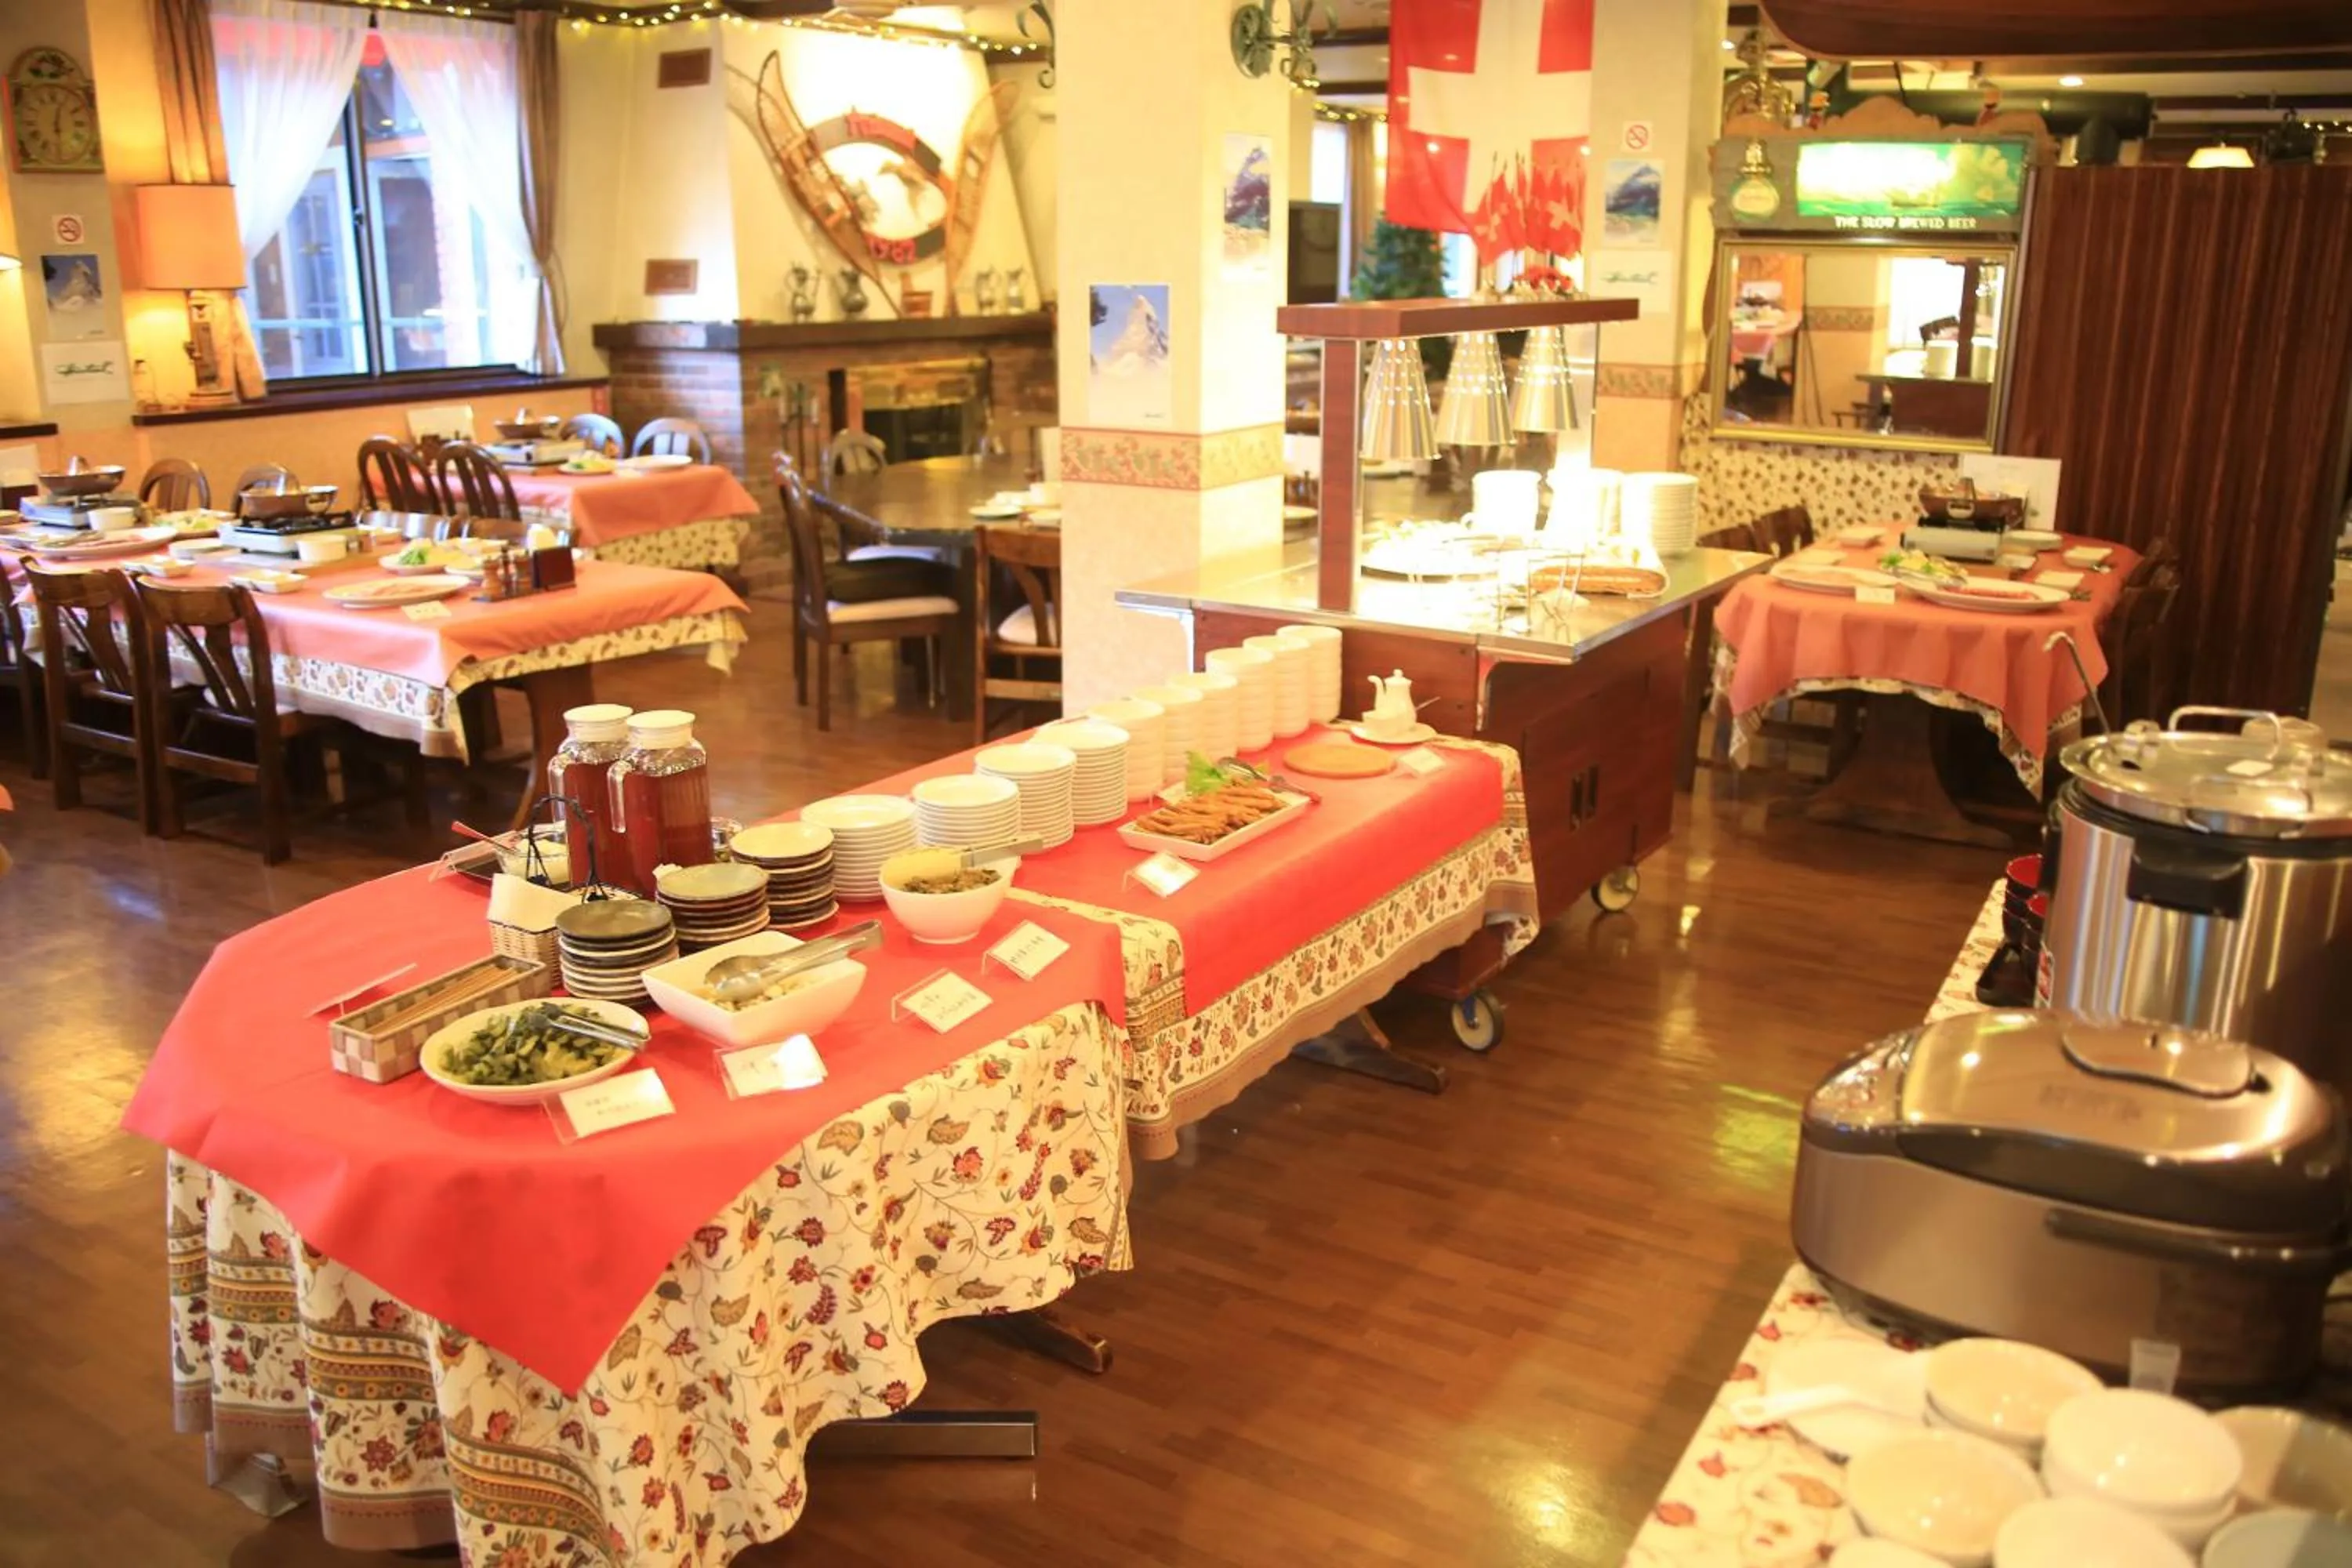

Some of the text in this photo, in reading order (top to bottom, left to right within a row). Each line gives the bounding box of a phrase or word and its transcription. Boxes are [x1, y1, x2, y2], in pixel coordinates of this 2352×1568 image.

[1835, 216, 1976, 229] THE SLOW BREWED BEER
